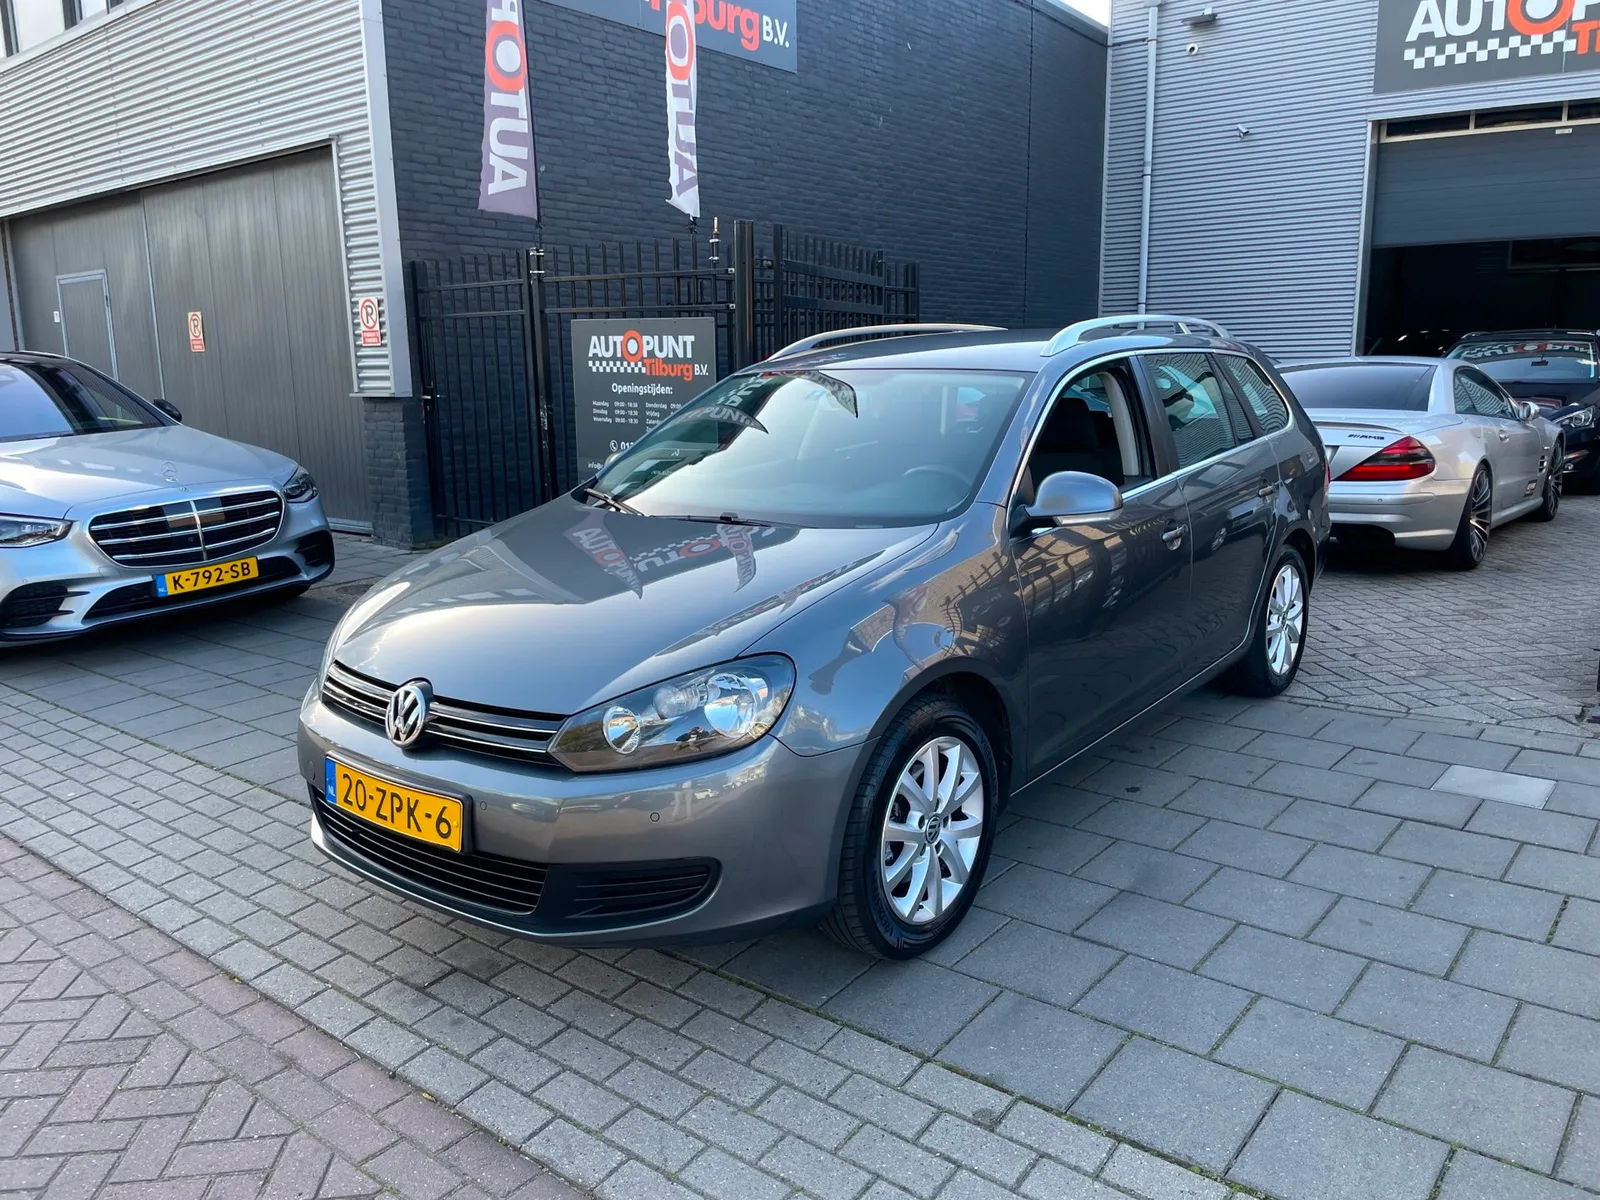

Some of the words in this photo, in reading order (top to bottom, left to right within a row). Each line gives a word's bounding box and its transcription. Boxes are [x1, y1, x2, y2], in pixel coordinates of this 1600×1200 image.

[762, 14, 790, 48] B.V.
[588, 329, 695, 362] AUTOPUNT
[644, 358, 693, 382] Tilburg
[694, 364, 709, 376] B.V.
[611, 382, 673, 396] Openingstijden:
[172, 561, 251, 591] K-792-SB
[328, 784, 336, 797] NL
[342, 773, 452, 839] 20-ZPK-6
